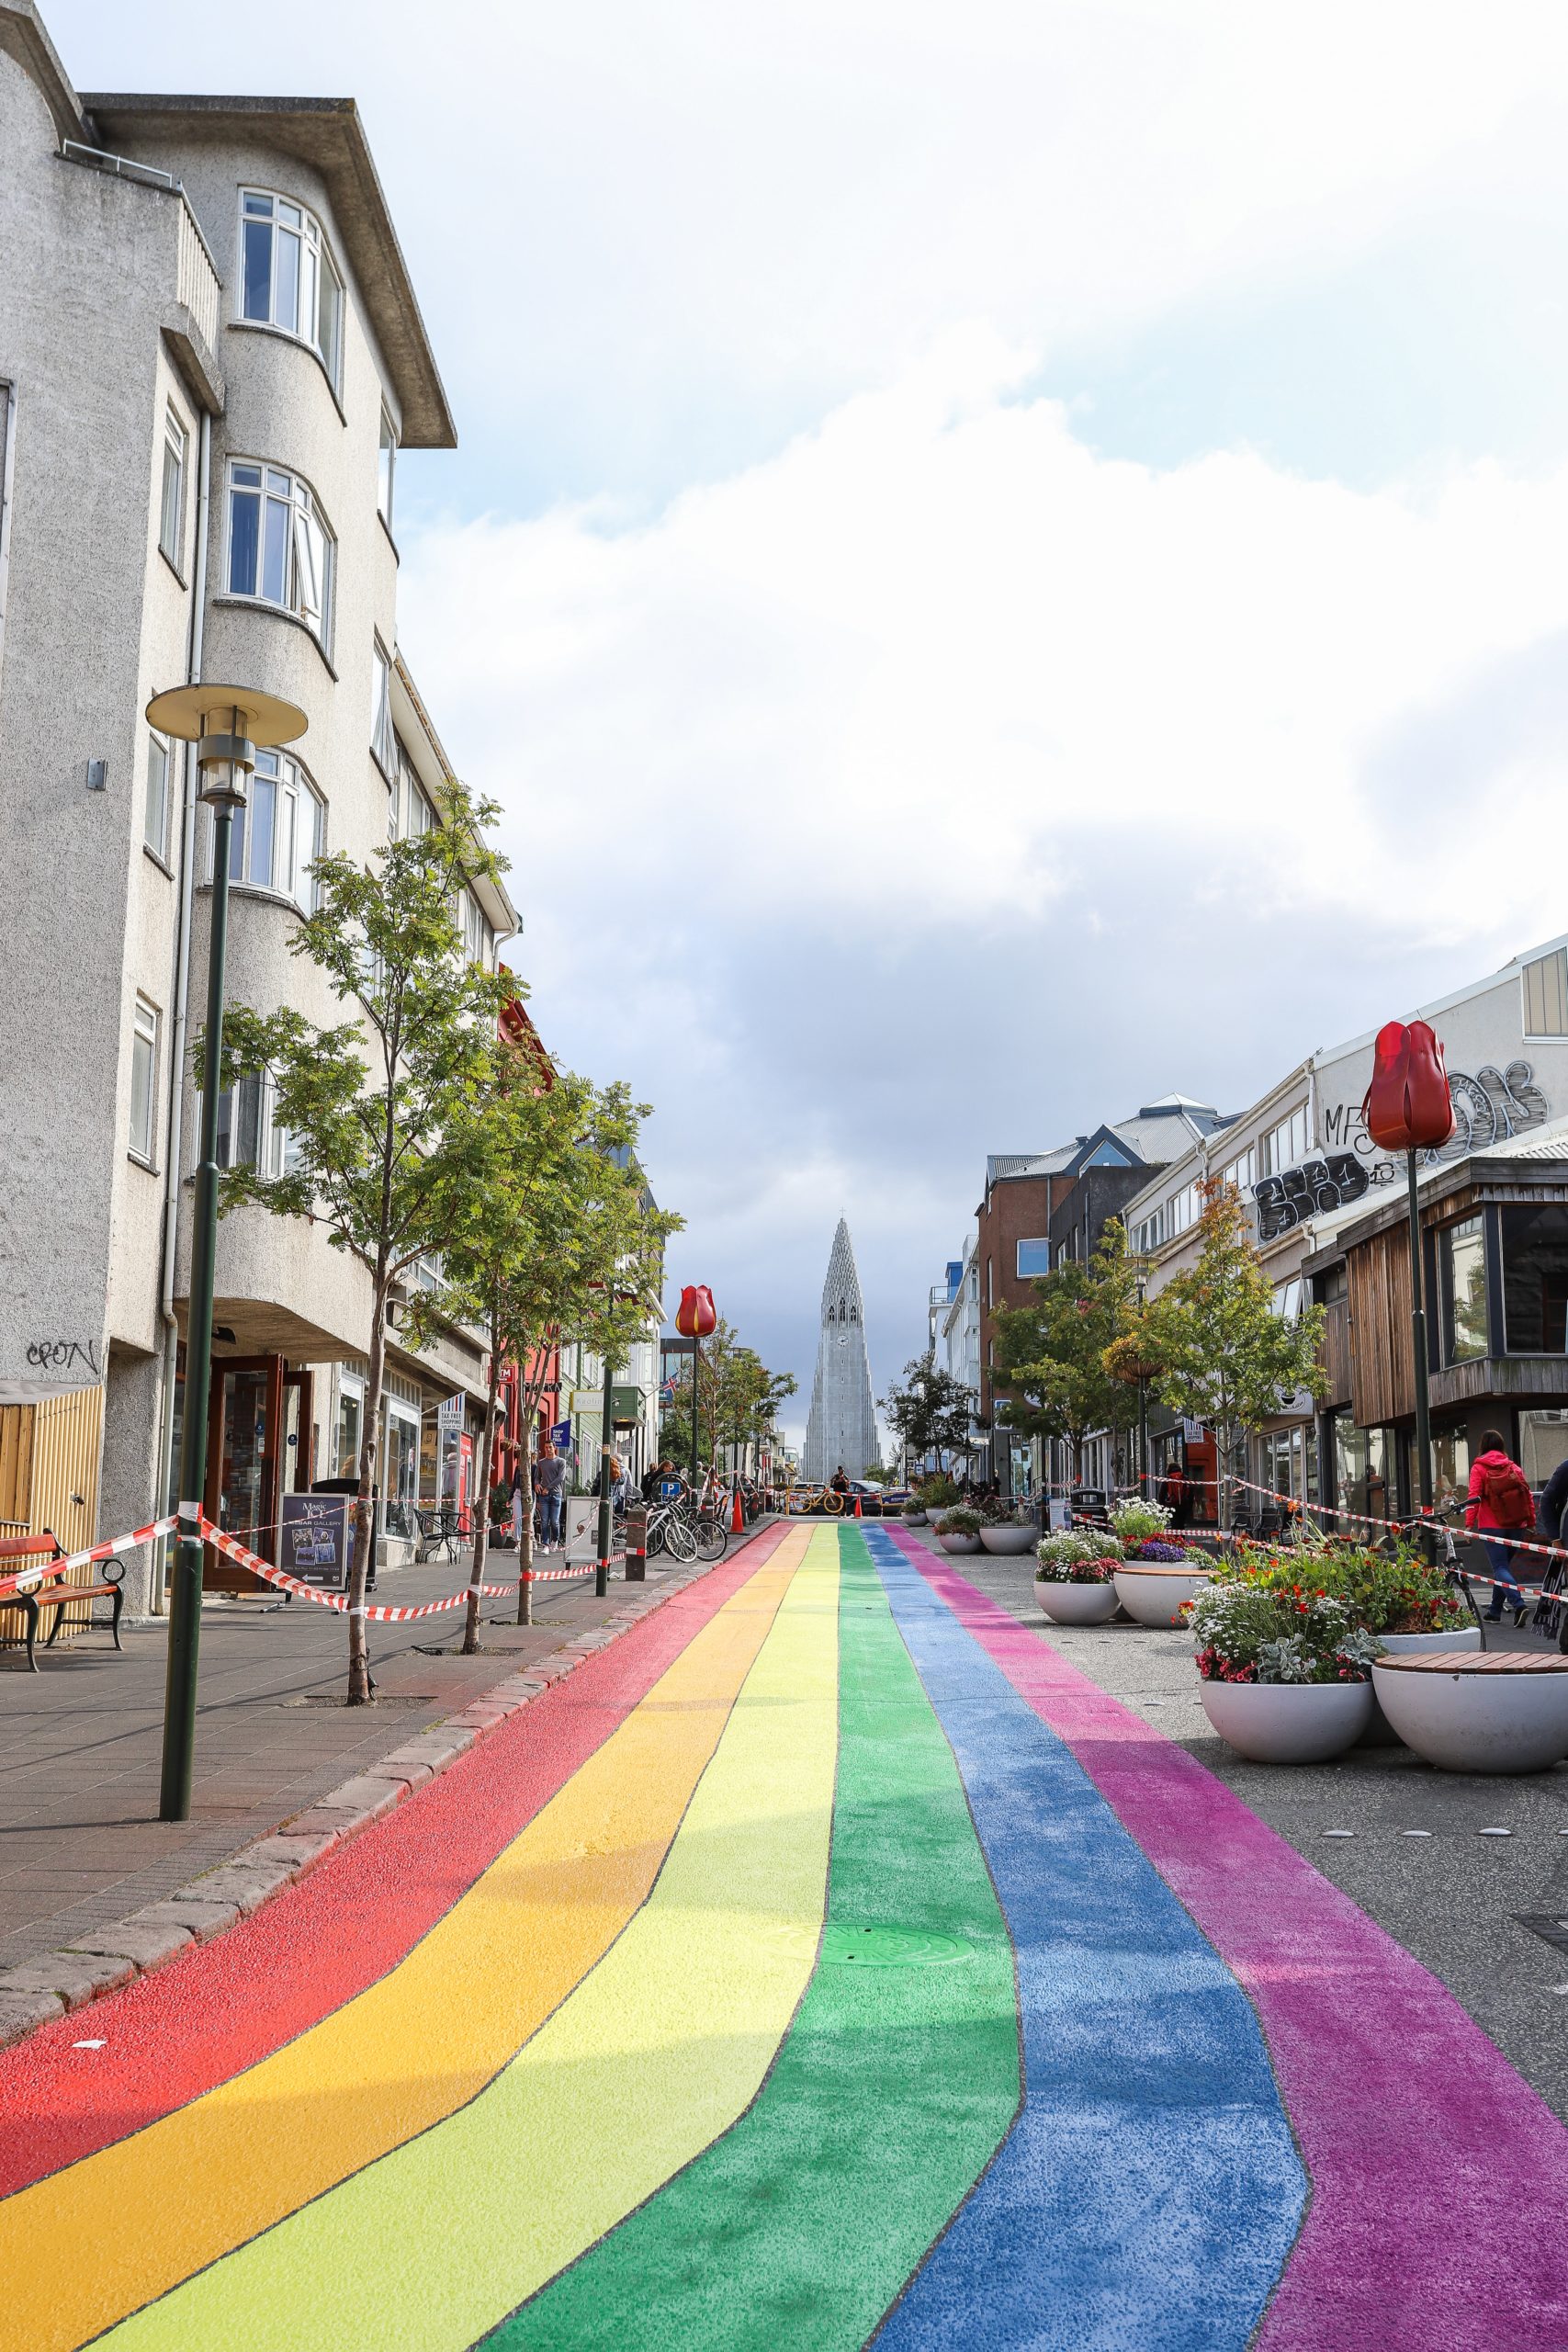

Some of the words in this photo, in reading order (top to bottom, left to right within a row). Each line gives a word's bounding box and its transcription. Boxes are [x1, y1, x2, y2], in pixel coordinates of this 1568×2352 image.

[525, 1383, 561, 1391] MOKA
[667, 1484, 675, 1493] P
[302, 1502, 327, 1511] Magic
